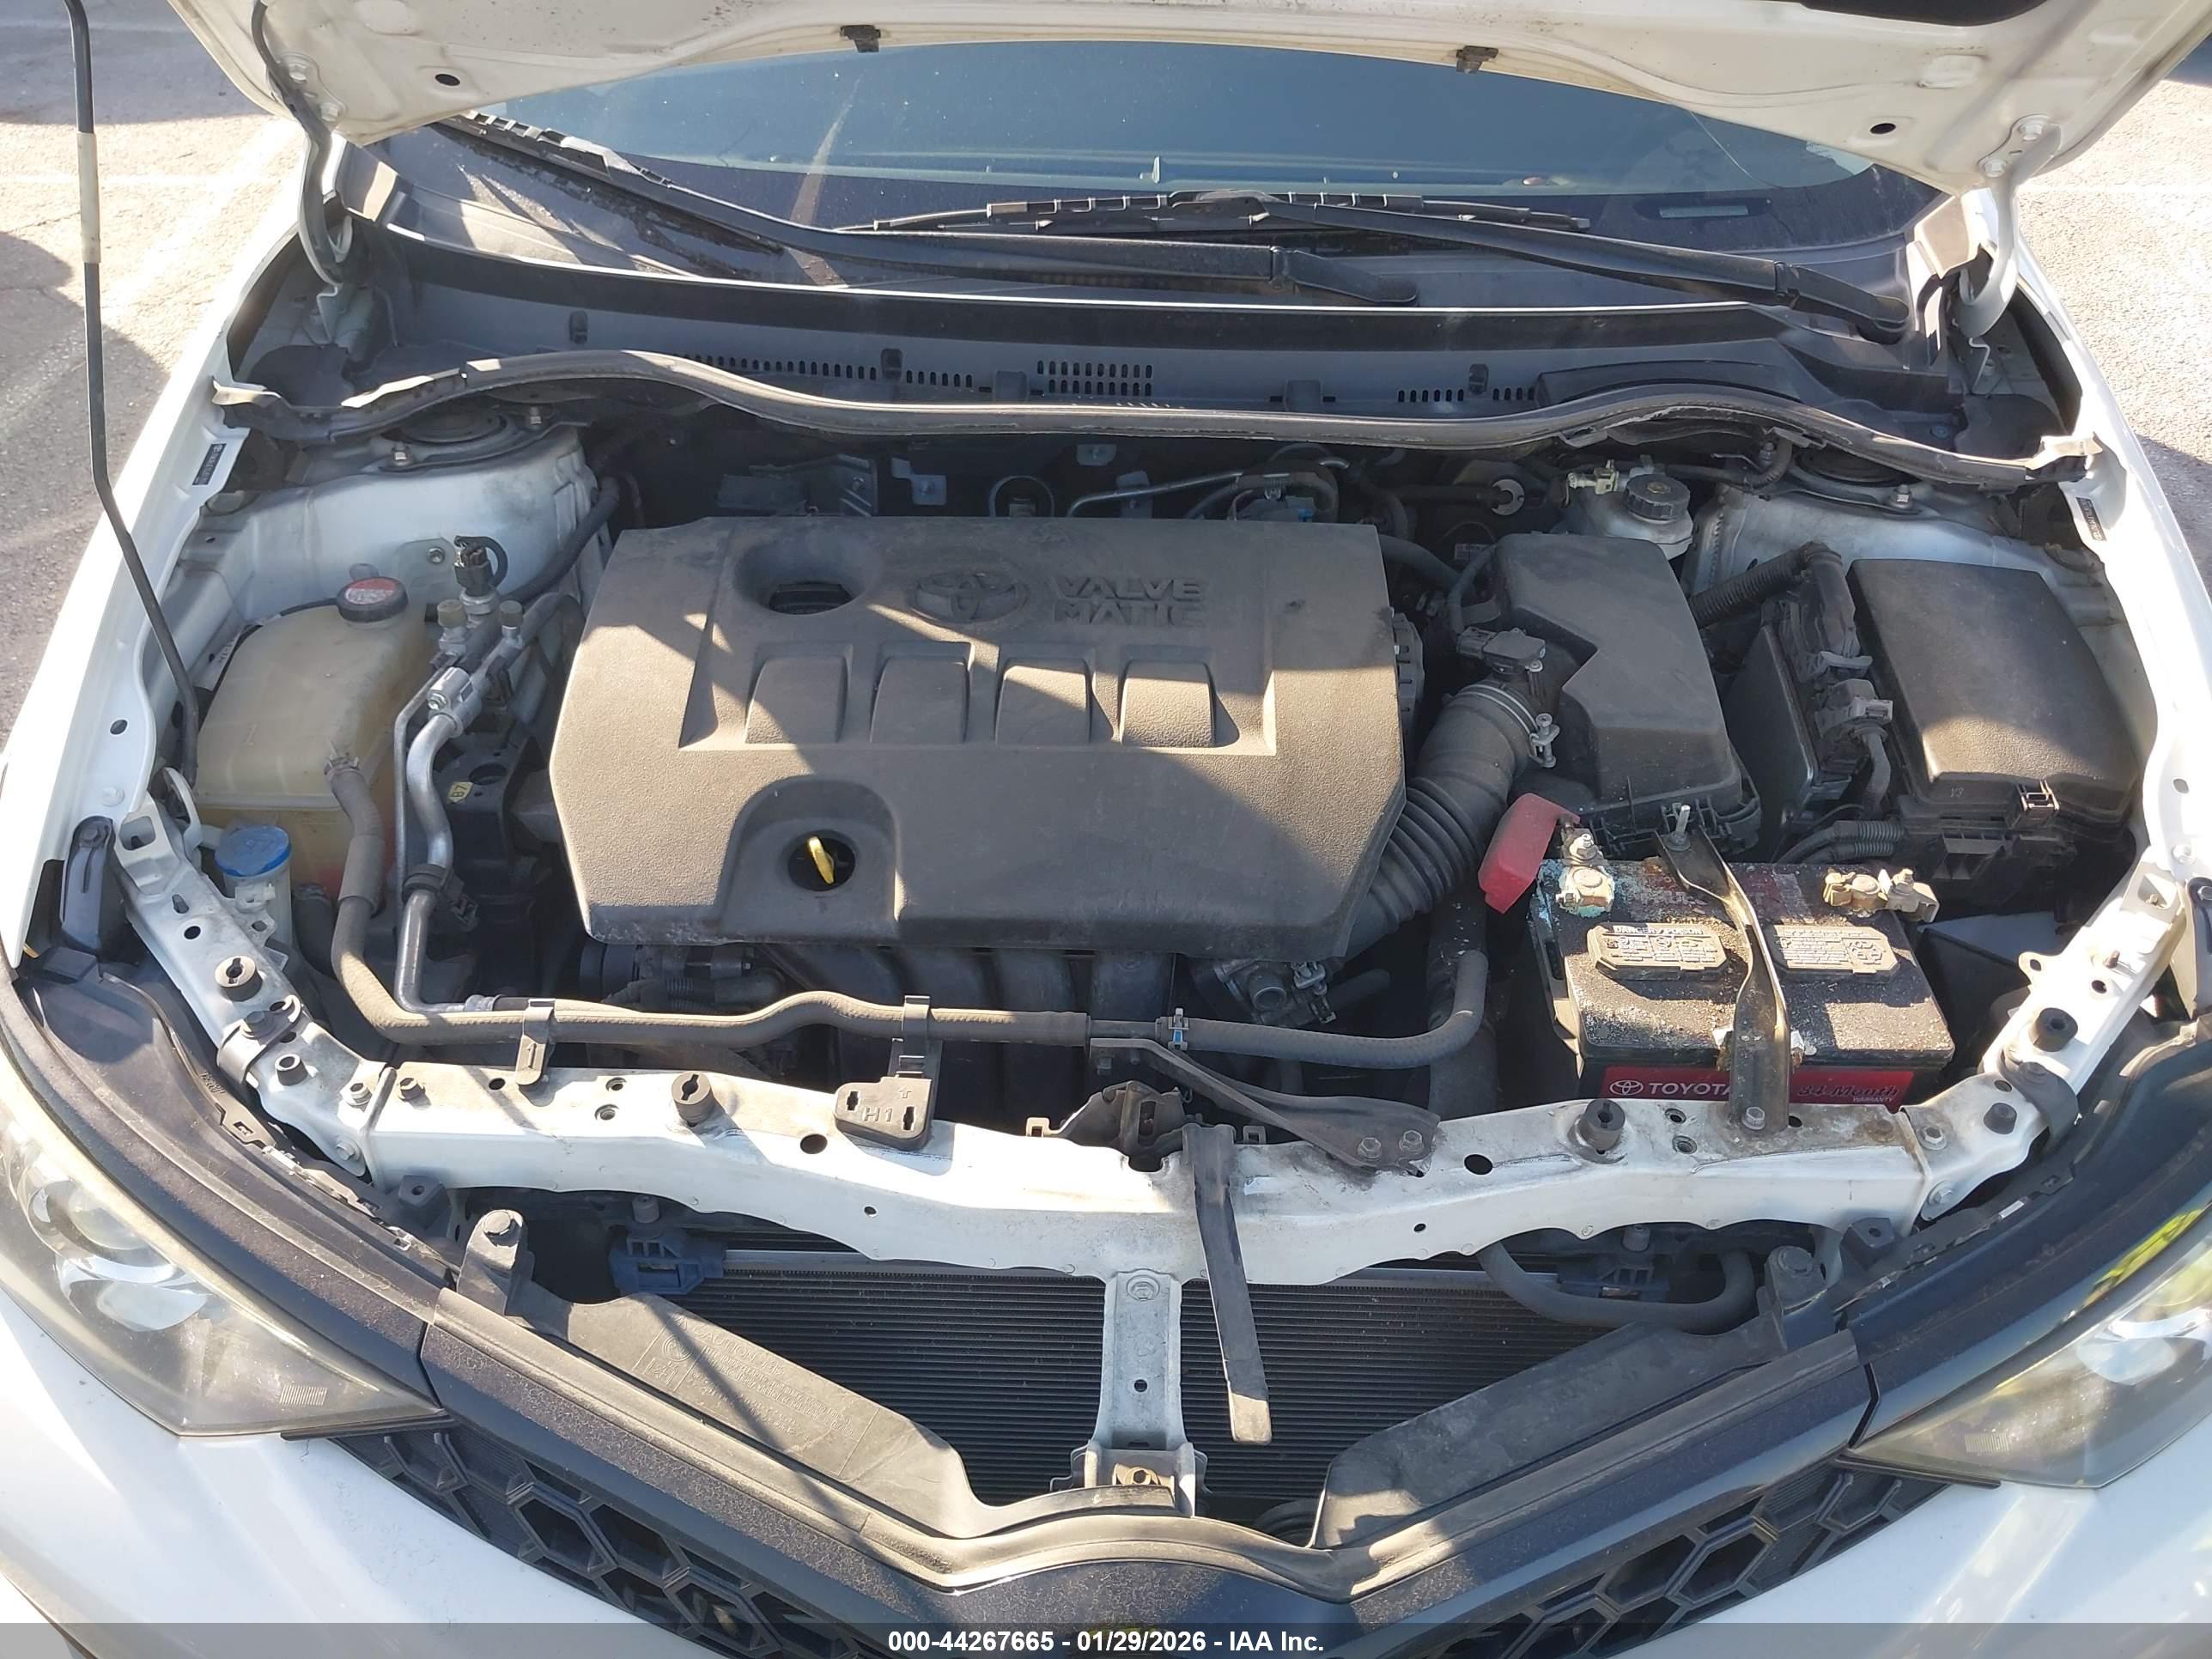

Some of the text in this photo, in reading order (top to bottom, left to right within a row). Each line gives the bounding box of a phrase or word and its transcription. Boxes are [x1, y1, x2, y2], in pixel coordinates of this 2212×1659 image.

[1049, 577, 1203, 602] VALVE
[1053, 602, 1204, 626] MATIC
[862, 1106, 893, 1122] H1
[693, 1323, 757, 1362] CAUTION
